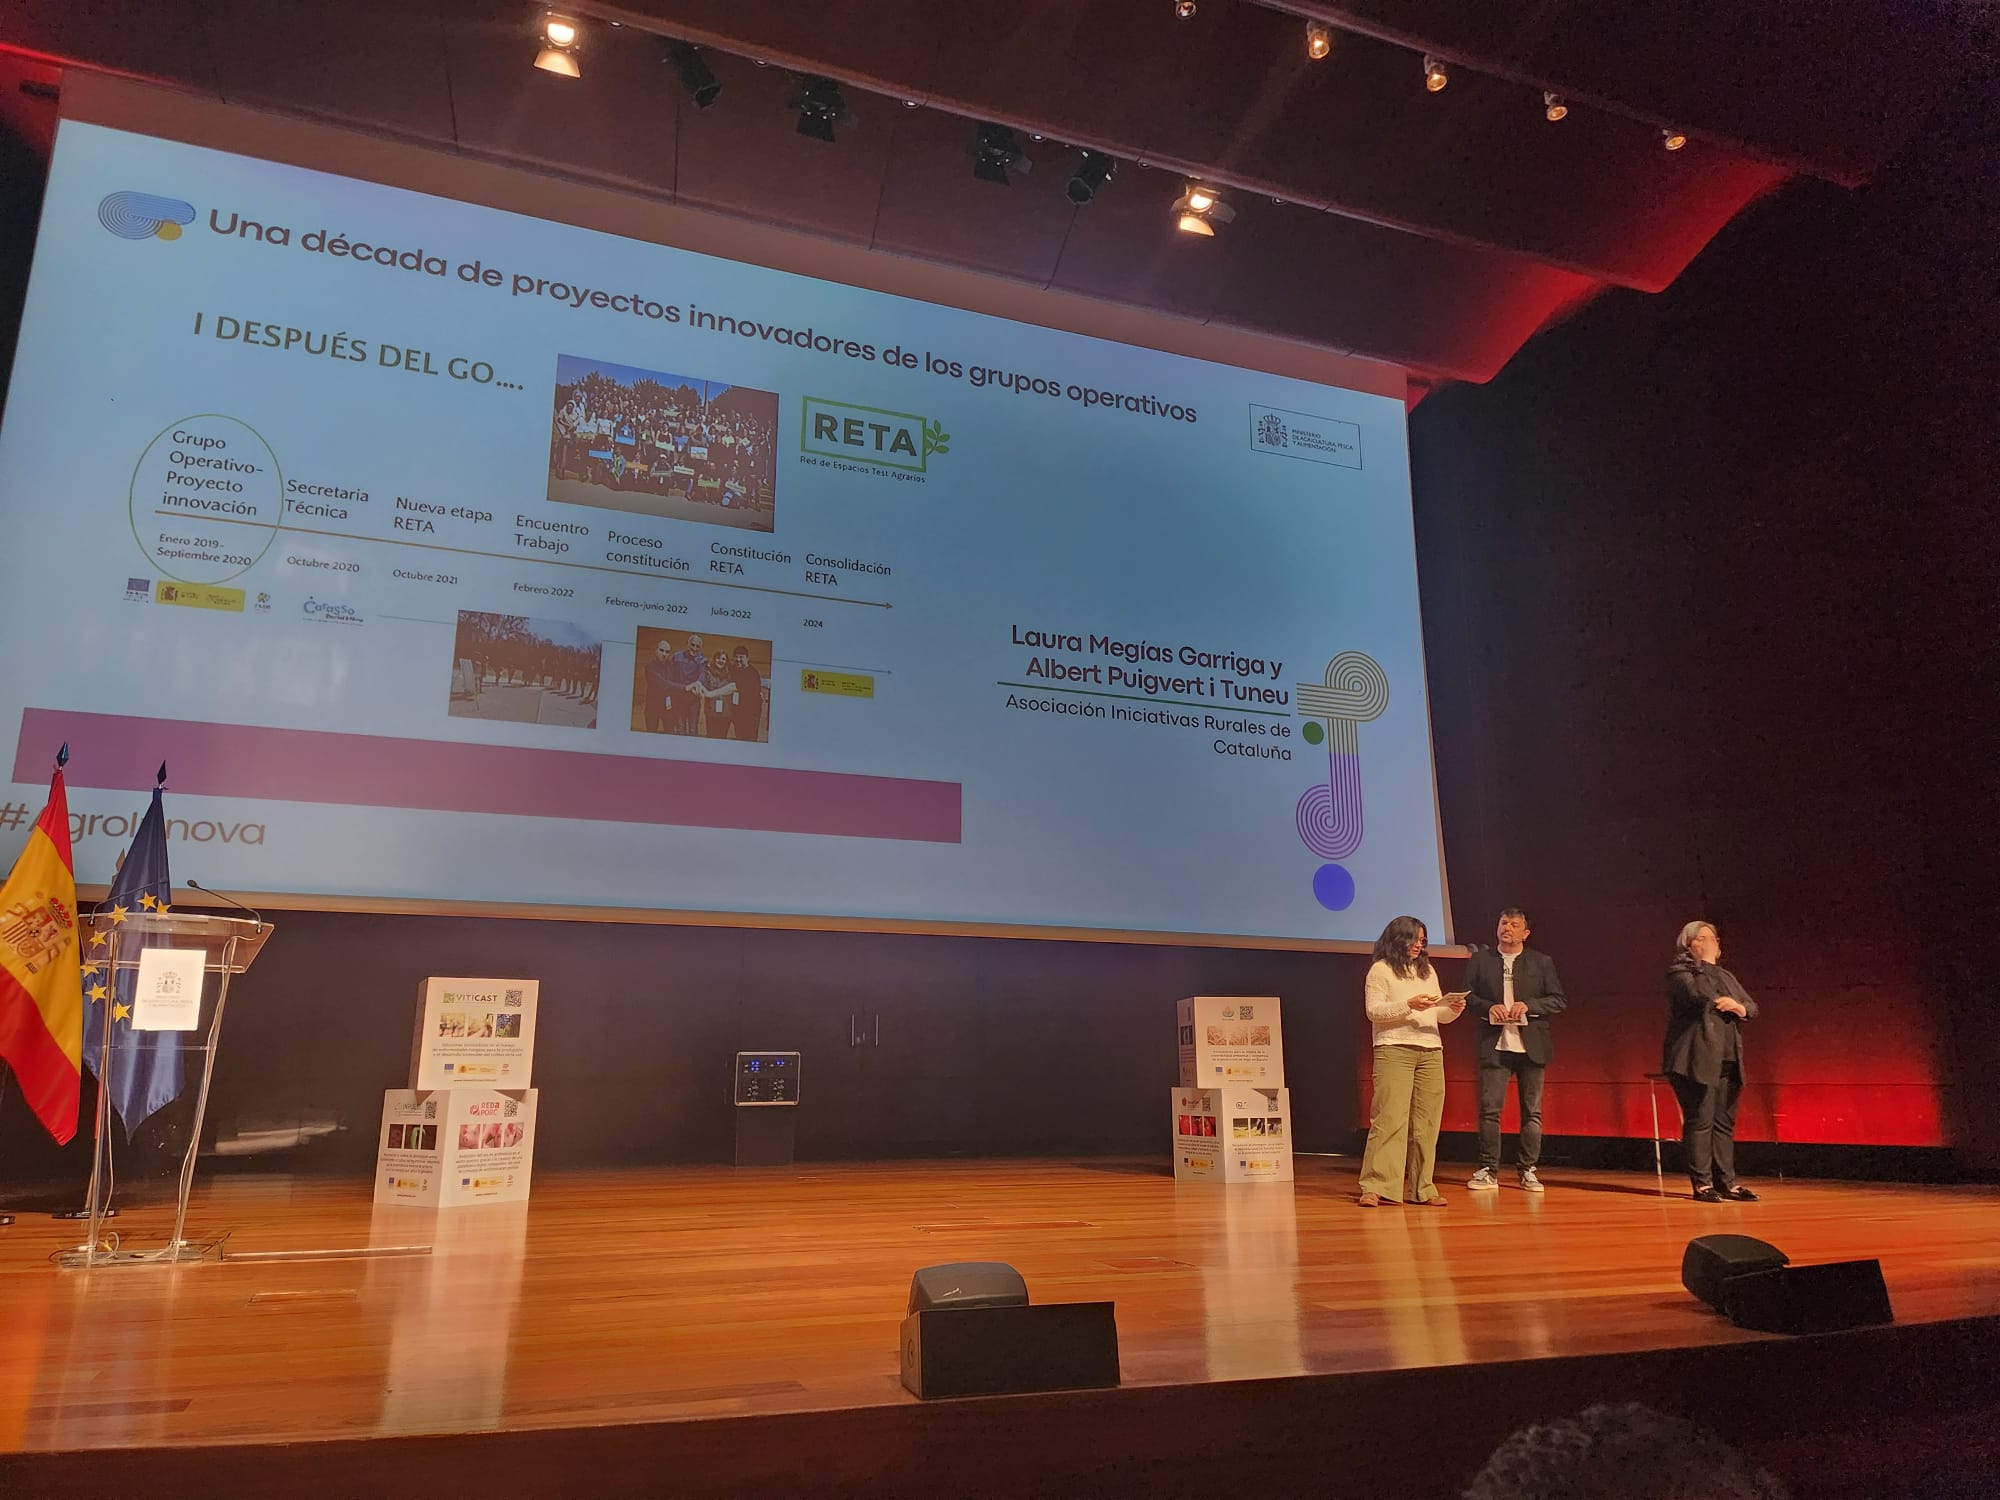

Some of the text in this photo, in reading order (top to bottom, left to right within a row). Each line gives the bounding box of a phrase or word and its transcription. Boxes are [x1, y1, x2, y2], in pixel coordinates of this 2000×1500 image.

[209, 209, 1197, 423] Una década de proyectos innovadores de los grupos operativos
[194, 312, 203, 334] I
[216, 316, 367, 362] DESPUÉS
[379, 344, 439, 375] DEL
[172, 430, 226, 450] Grupo
[814, 412, 917, 457] RETA
[169, 450, 263, 474] Operativo-
[800, 455, 925, 483] Red de Espacios Test Agrarios
[166, 471, 243, 493] Proyecto
[287, 479, 369, 502] Secretaria
[162, 491, 257, 516] innovación
[285, 499, 347, 519] Técnica
[396, 497, 492, 524] Nueva etapa
[394, 517, 435, 533] RETA
[516, 515, 589, 536] Encuentro
[159, 533, 224, 549] Enero 2019-
[515, 534, 569, 554] Trabajo
[608, 531, 663, 549] Proceso
[157, 547, 251, 566] Septiembre 2020
[606, 551, 690, 571] constitución
[710, 542, 791, 564] Constitución
[287, 556, 360, 573] Octubre 2020
[709, 561, 744, 575] RETA
[805, 553, 891, 576] Consolidación
[393, 569, 458, 585] Octubre 2021
[805, 571, 838, 586] RETA
[513, 582, 574, 597] Febrero 2022
[605, 596, 688, 615] Febrero-junio 2022
[711, 607, 751, 620] Julio 2022
[803, 618, 823, 629] 2024
[1012, 624, 1282, 680] Laura Megías Garriga y
[1026, 657, 1289, 705] Albert Puigvert i Tuneu
[1006, 694, 1291, 737] Asociación Iniciativas Rurales de
[1214, 740, 1291, 761] Cataluña
[456, 994, 498, 1002] VITICAST
